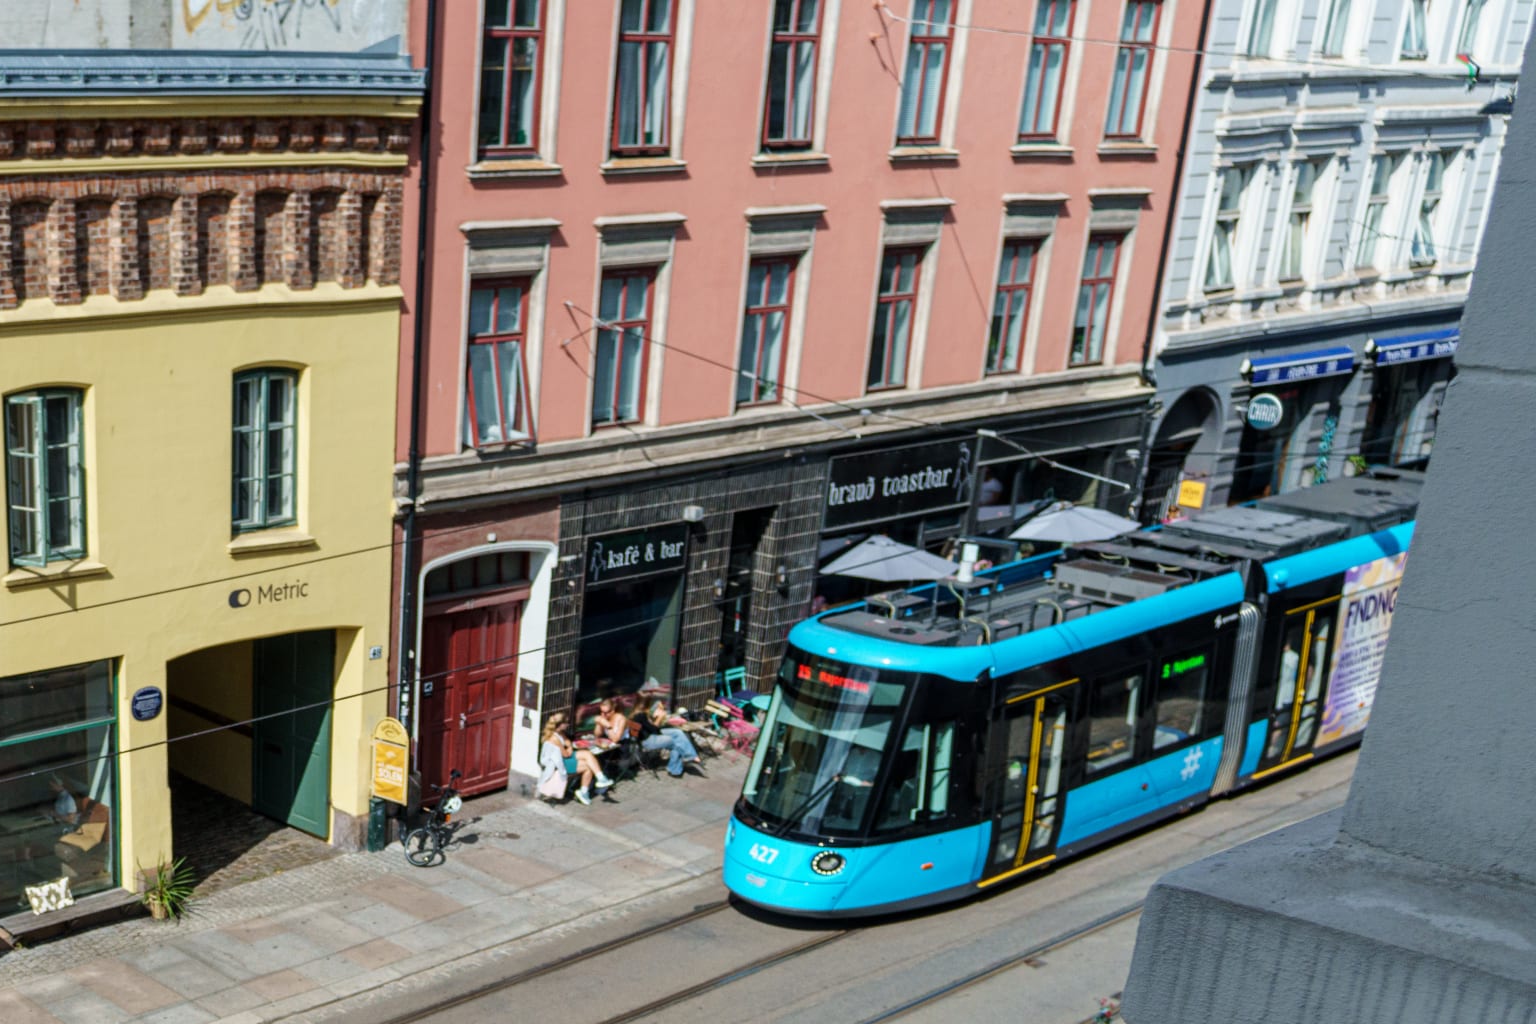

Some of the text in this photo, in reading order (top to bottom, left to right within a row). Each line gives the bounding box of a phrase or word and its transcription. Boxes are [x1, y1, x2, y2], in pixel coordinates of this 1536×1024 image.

[883, 466, 952, 496] toastbar
[645, 543, 654, 562] &
[661, 541, 684, 559] bar
[258, 580, 308, 605] Metric
[749, 843, 779, 864] 427
